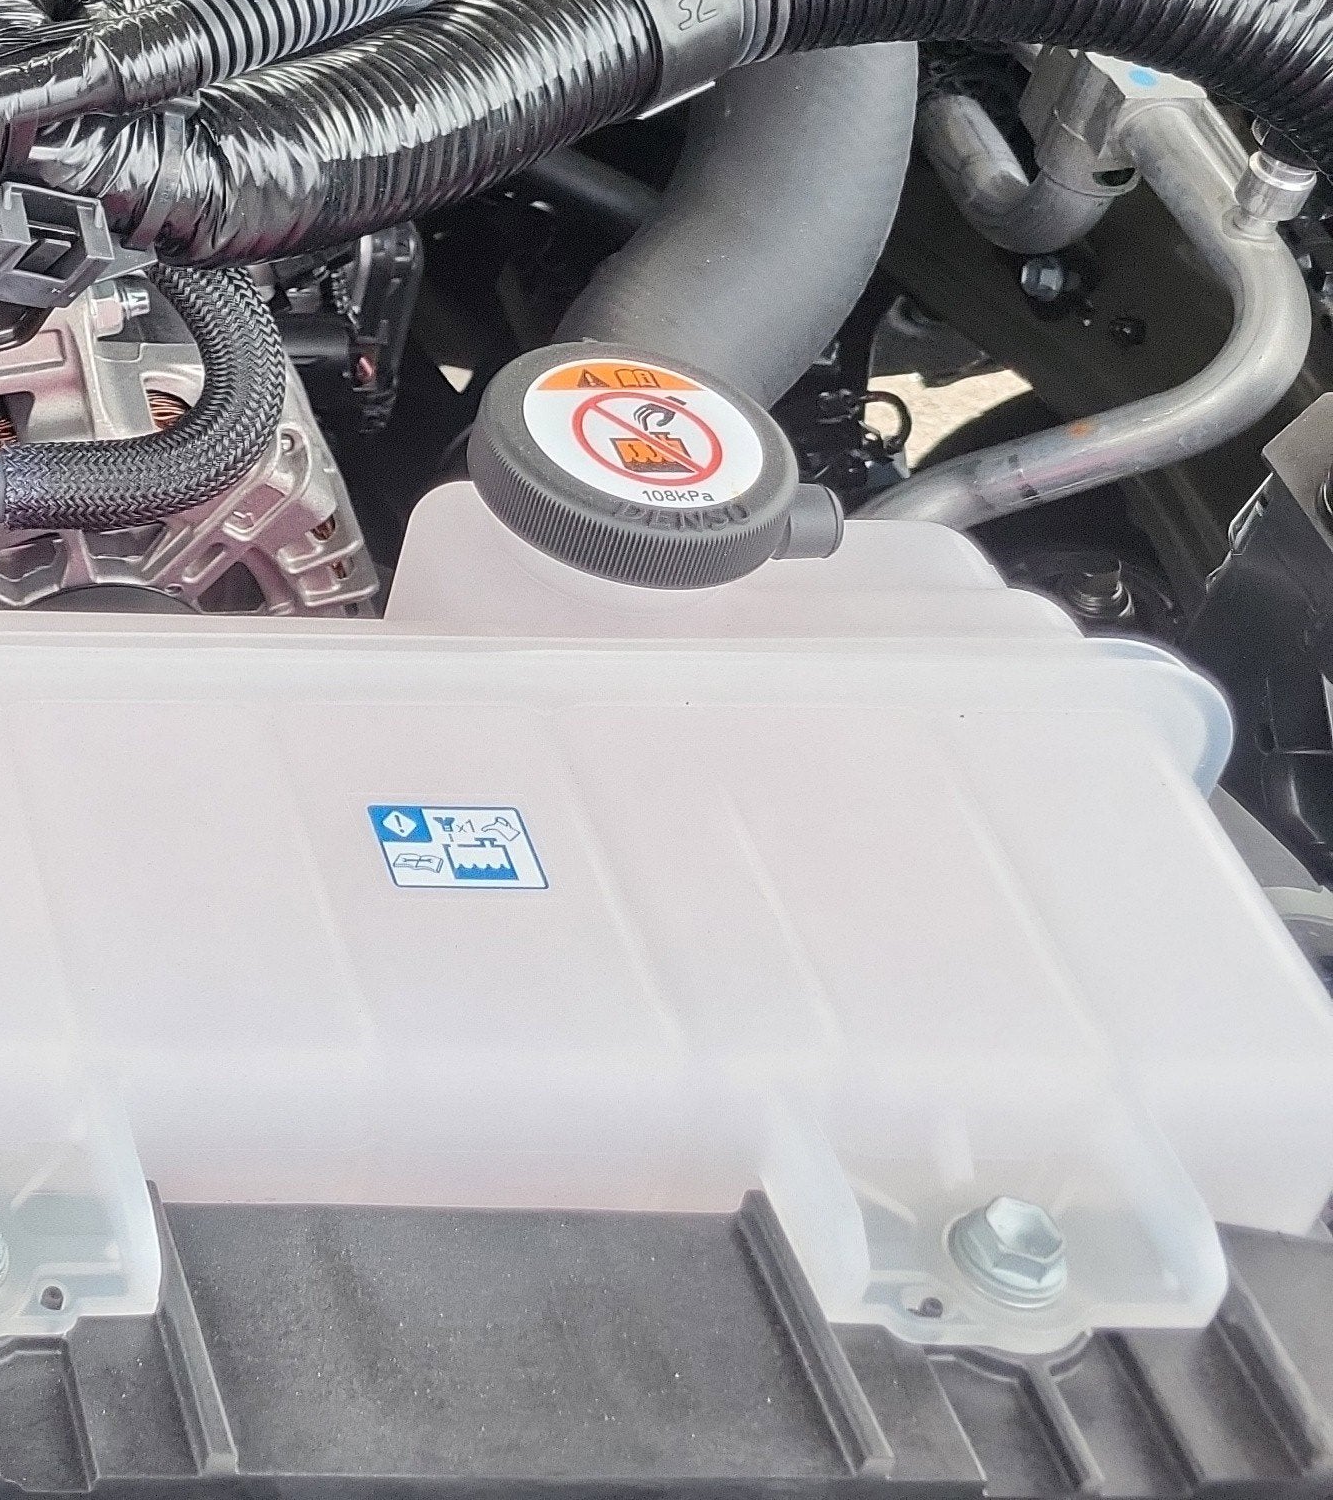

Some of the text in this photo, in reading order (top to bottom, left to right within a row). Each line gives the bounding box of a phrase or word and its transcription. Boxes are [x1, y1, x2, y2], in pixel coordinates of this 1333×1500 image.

[641, 489, 715, 503] 108kPa
[617, 500, 752, 532] DENSO
[455, 818, 475, 833] x1
